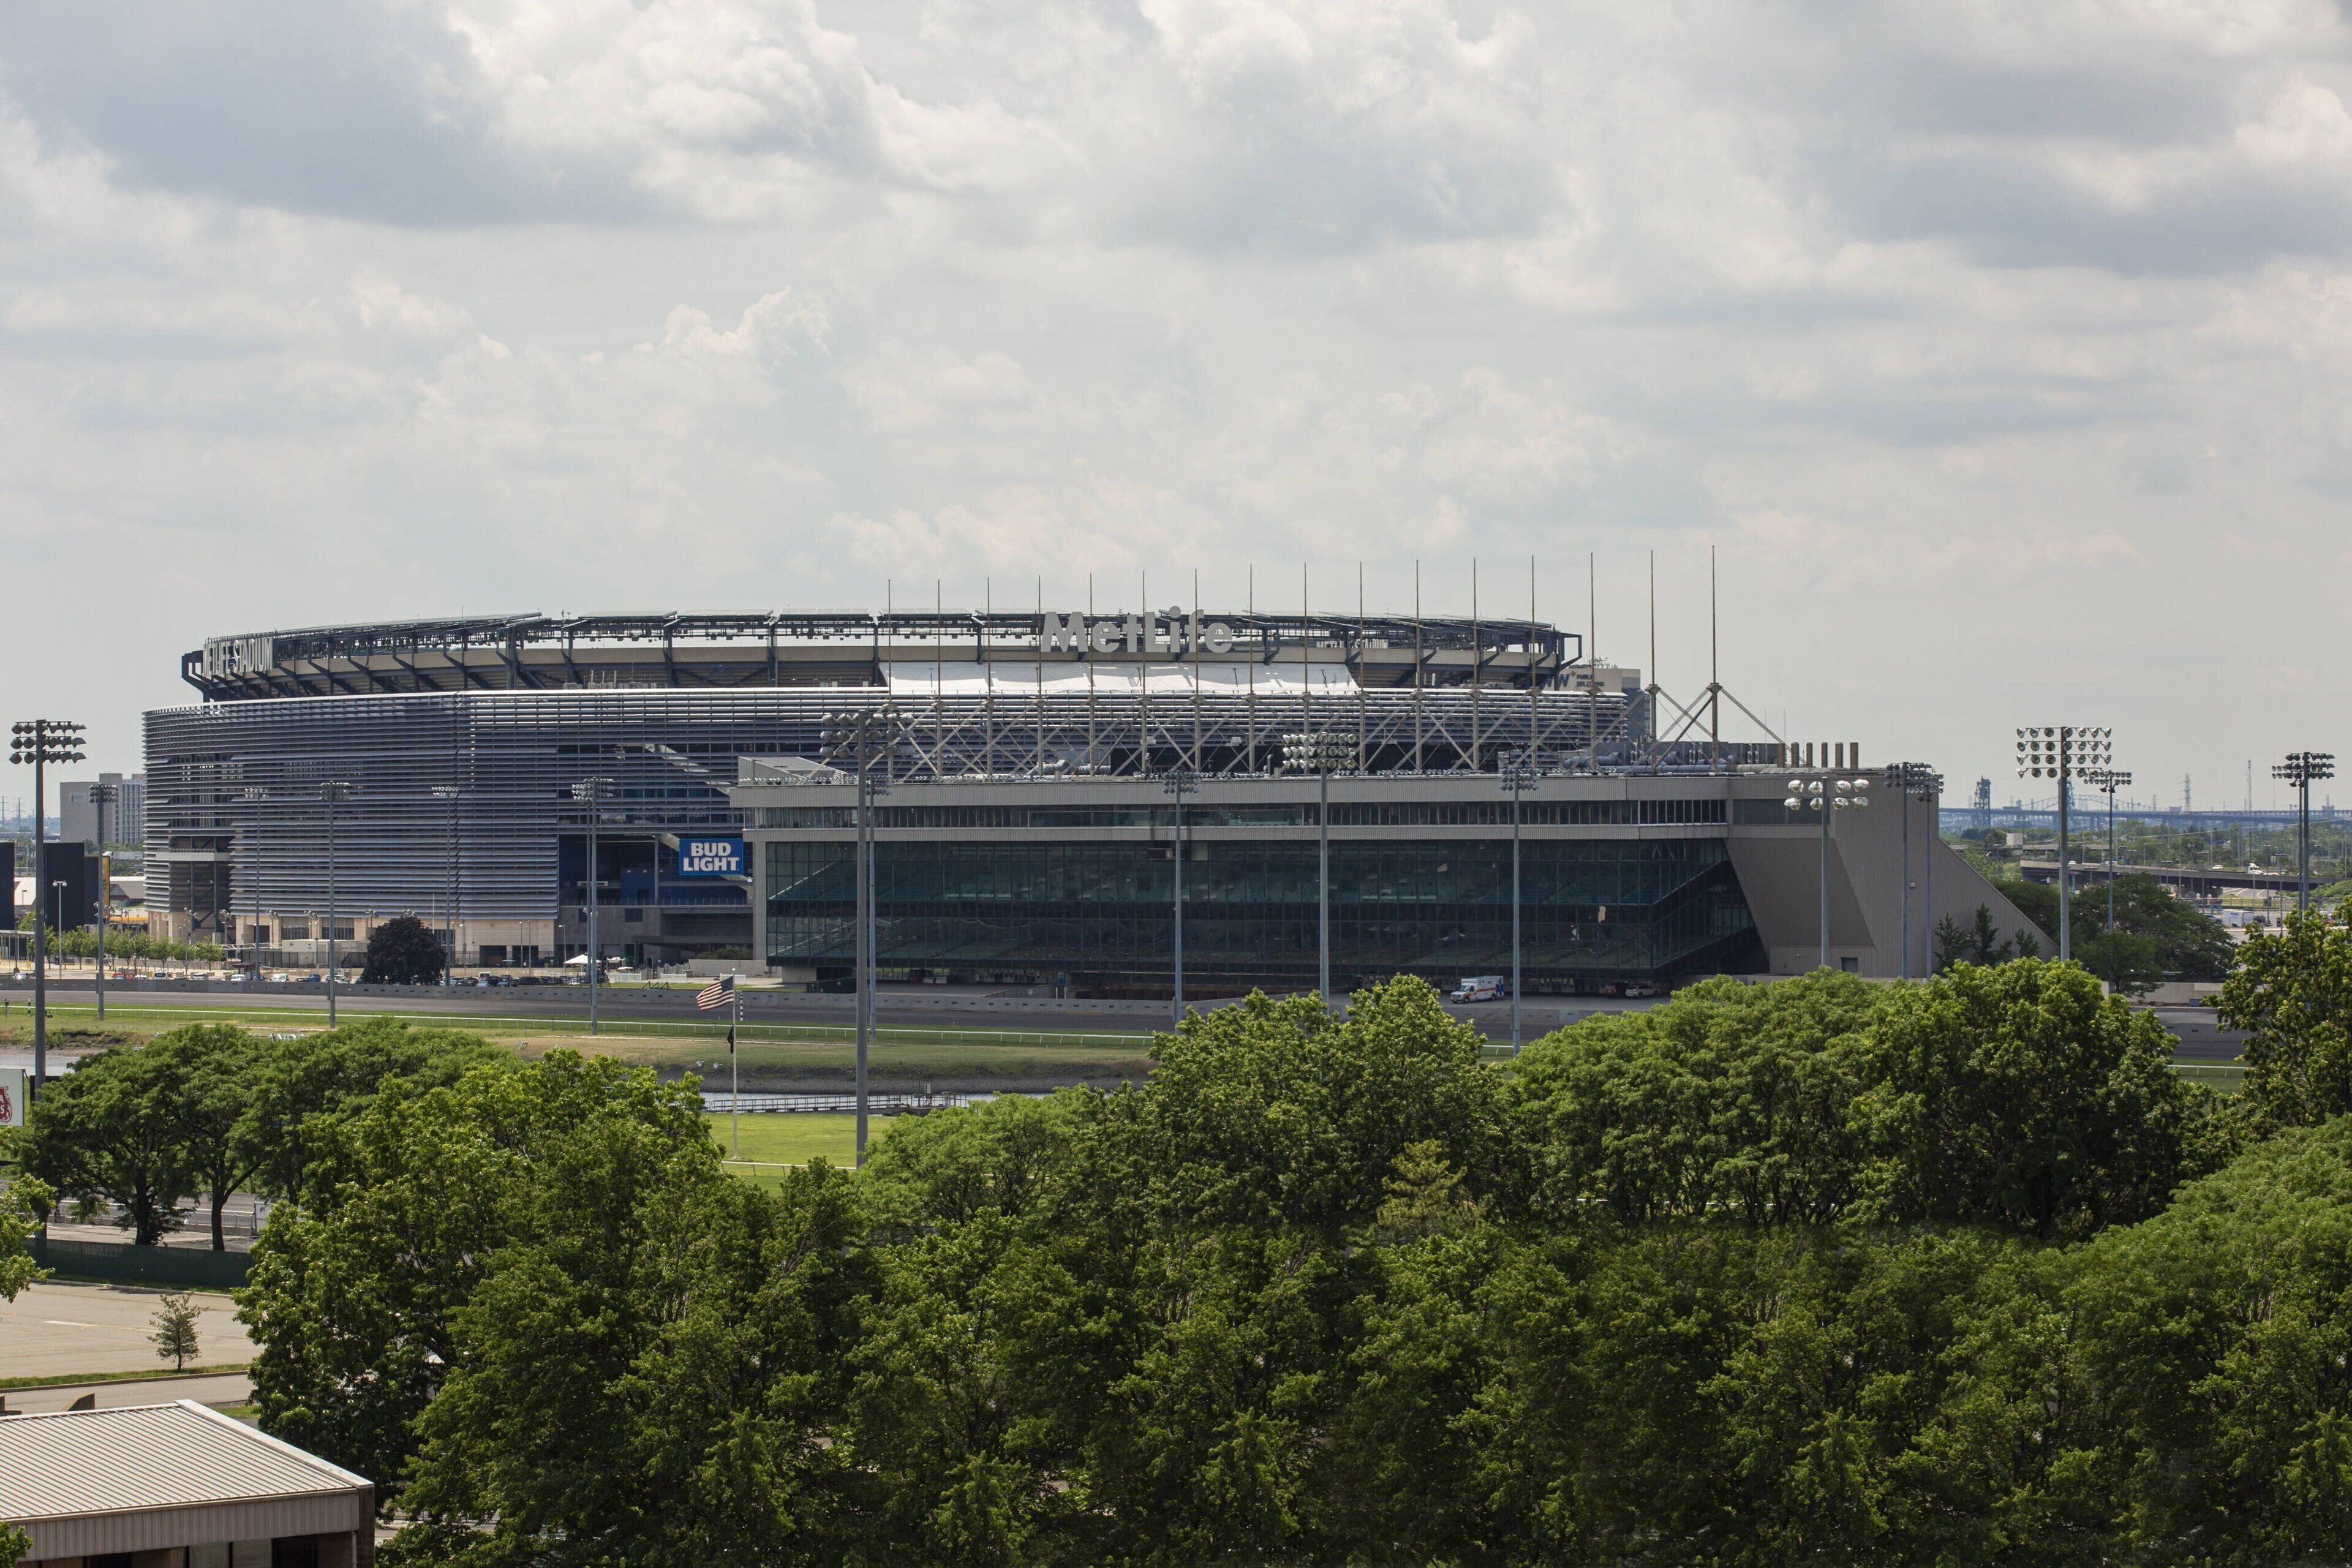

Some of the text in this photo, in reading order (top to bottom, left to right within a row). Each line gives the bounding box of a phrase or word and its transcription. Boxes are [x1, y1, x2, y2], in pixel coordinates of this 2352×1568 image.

[1042, 606, 1233, 653] MetLife
[691, 842, 731, 856] BUD
[683, 858, 739, 871] LIGHT
